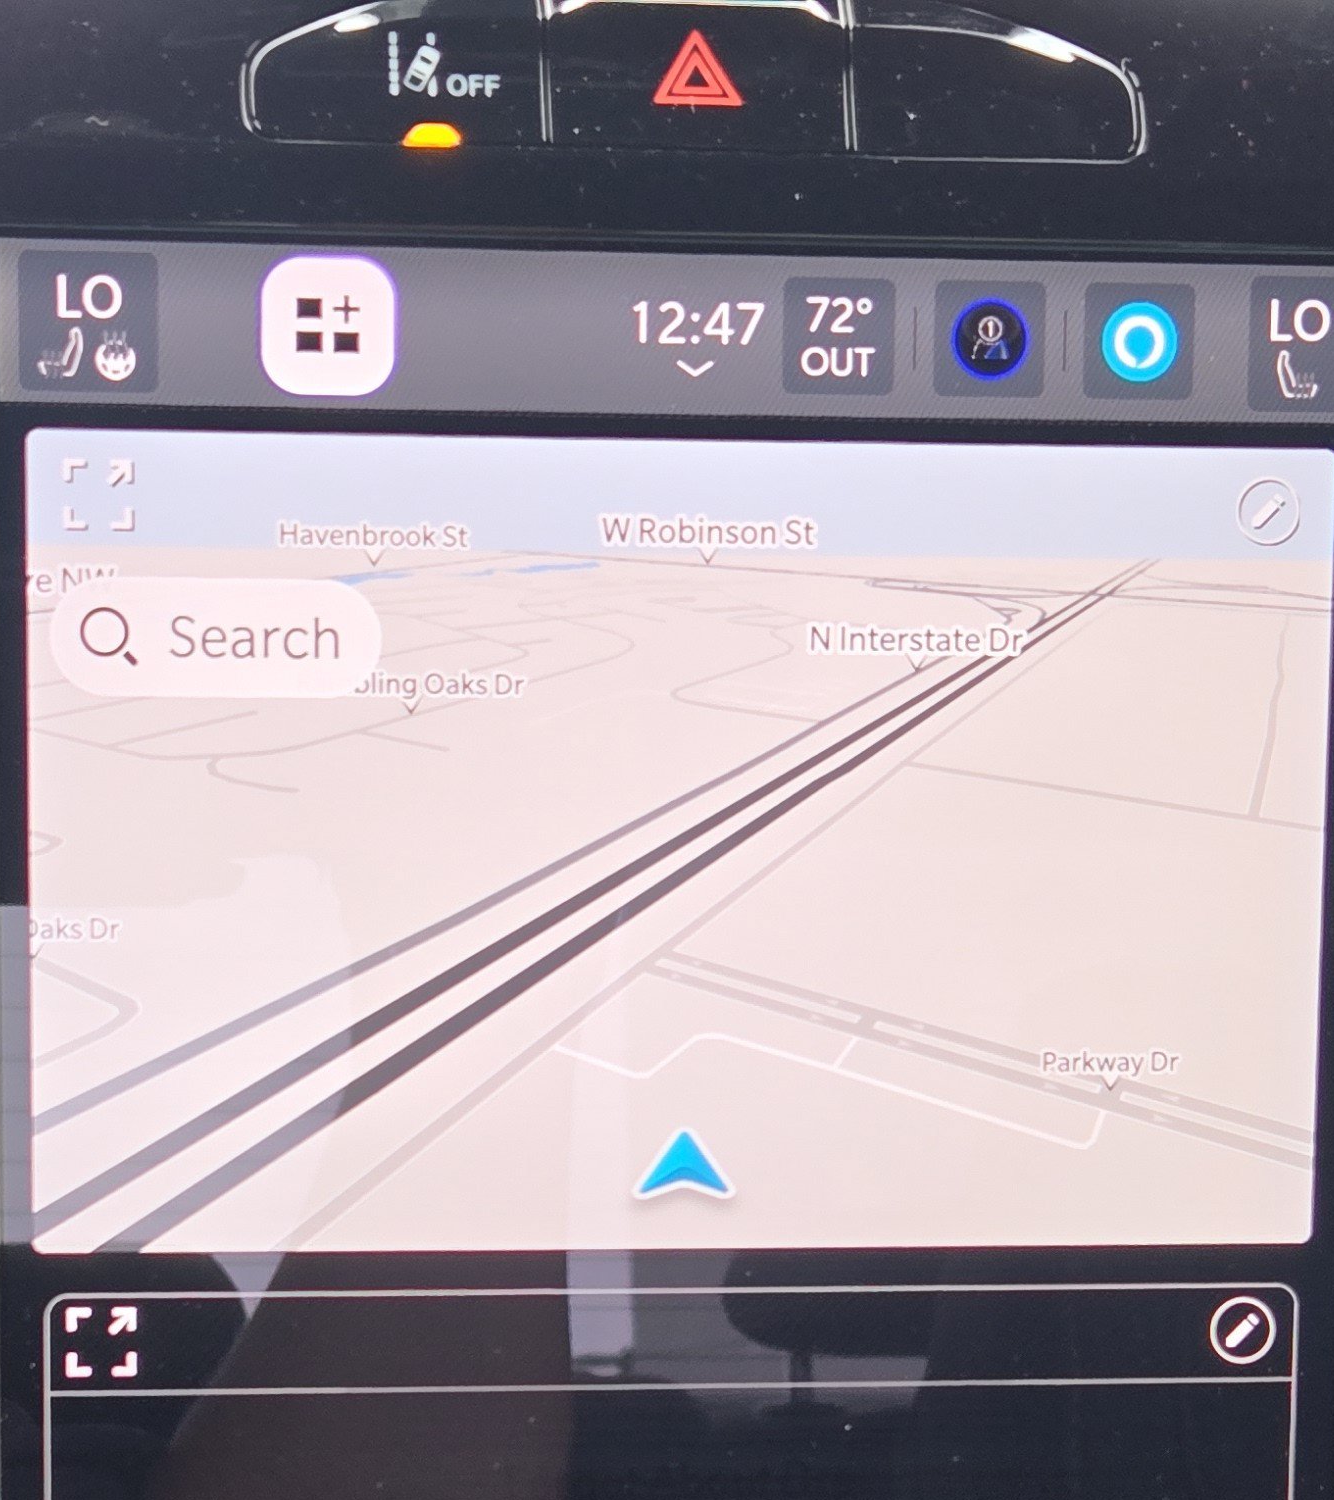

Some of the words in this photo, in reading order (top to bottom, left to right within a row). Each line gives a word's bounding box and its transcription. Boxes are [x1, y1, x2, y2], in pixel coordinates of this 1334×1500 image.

[447, 73, 501, 99] OFF
[55, 273, 124, 320] LO
[632, 300, 766, 346] 12:47
[805, 296, 874, 334] 72°
[1269, 298, 1331, 343] LO
[800, 346, 877, 378] OUT
[279, 522, 436, 548] Havenbrook
[442, 525, 469, 548] St
[602, 517, 636, 546] W
[638, 517, 776, 546] Robinson
[782, 520, 815, 546] St
[169, 614, 340, 660] Search
[809, 626, 832, 652] N
[838, 625, 981, 653] Interstate
[989, 628, 1024, 653] Dr
[425, 673, 488, 695] Oaks
[495, 674, 524, 695] Dr
[90, 917, 120, 940] Dr
[1041, 1051, 1143, 1078] Parkway
[1148, 1051, 1179, 1073] Dr
